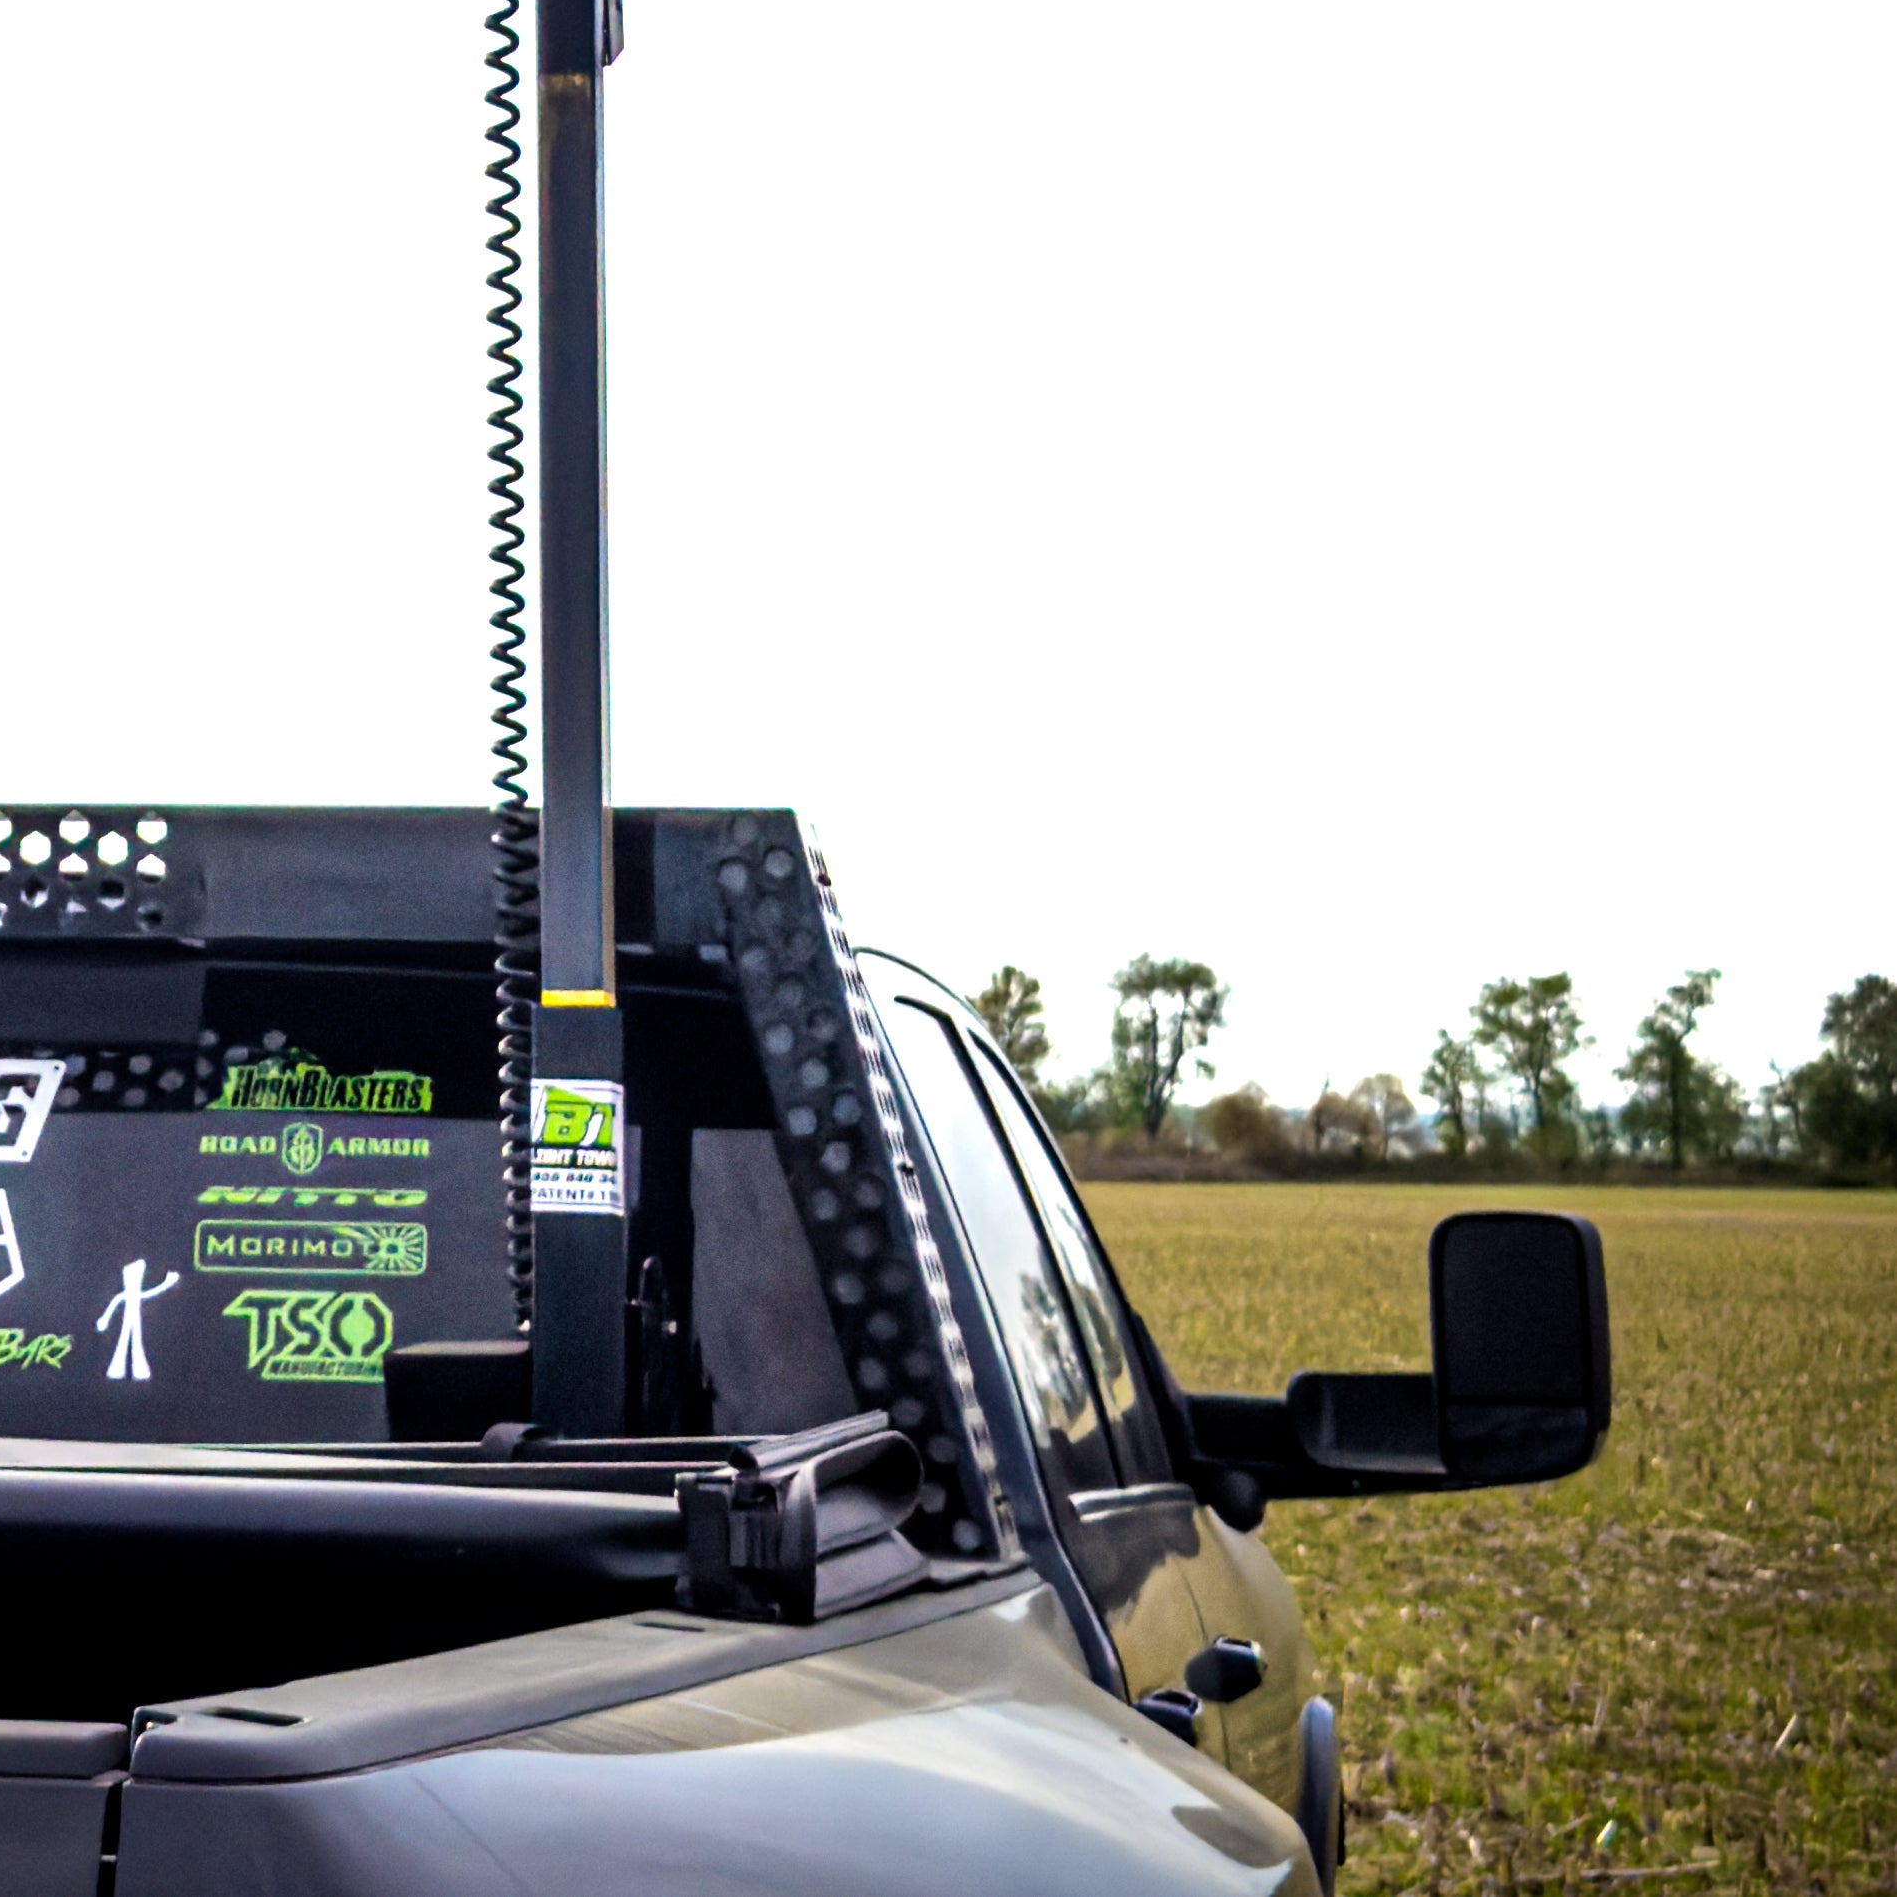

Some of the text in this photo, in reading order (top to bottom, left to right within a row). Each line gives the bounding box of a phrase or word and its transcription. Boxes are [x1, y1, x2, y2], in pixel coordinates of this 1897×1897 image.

[198, 1135, 431, 1158] ROAD ARMOR
[197, 1185, 428, 1206] NITTO
